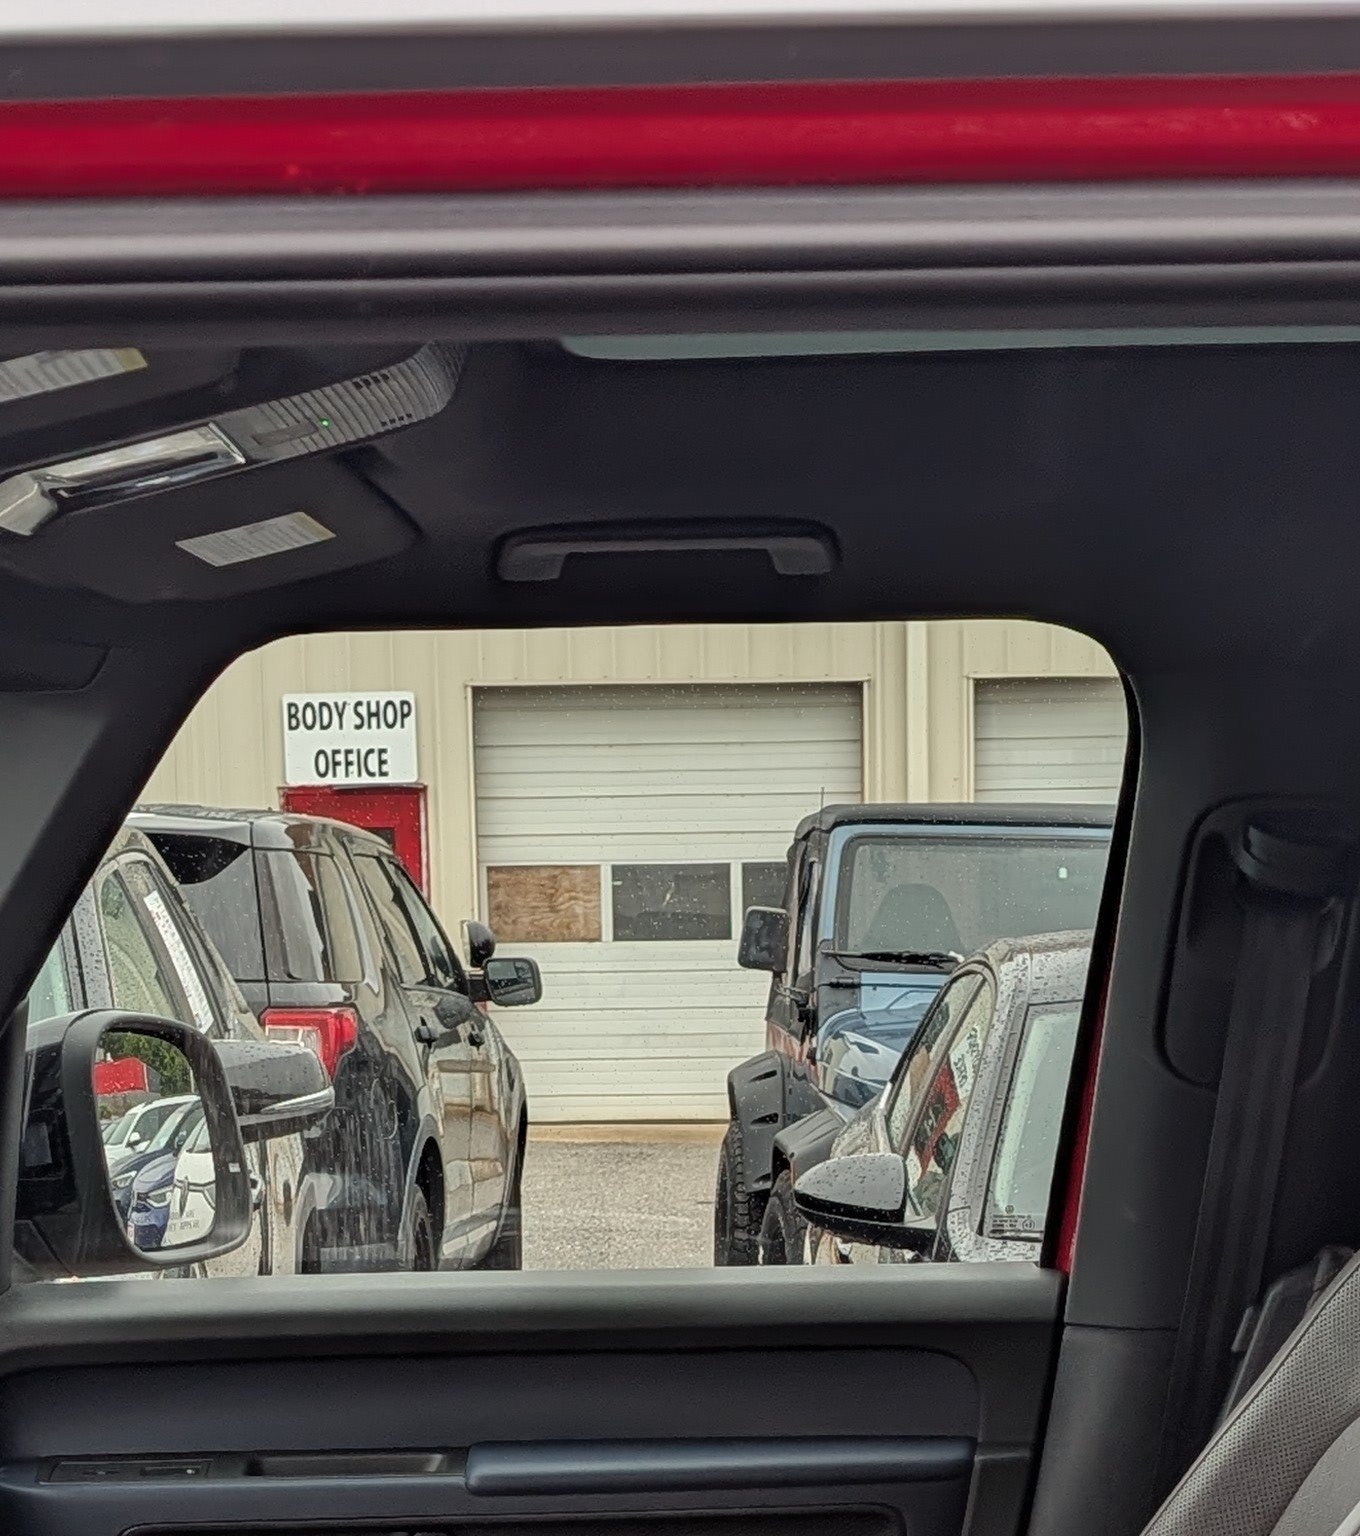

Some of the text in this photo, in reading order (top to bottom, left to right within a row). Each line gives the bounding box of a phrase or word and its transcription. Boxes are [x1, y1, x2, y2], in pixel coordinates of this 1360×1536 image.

[286, 699, 412, 731] BODY SHOP
[314, 747, 389, 778] OFFICE
